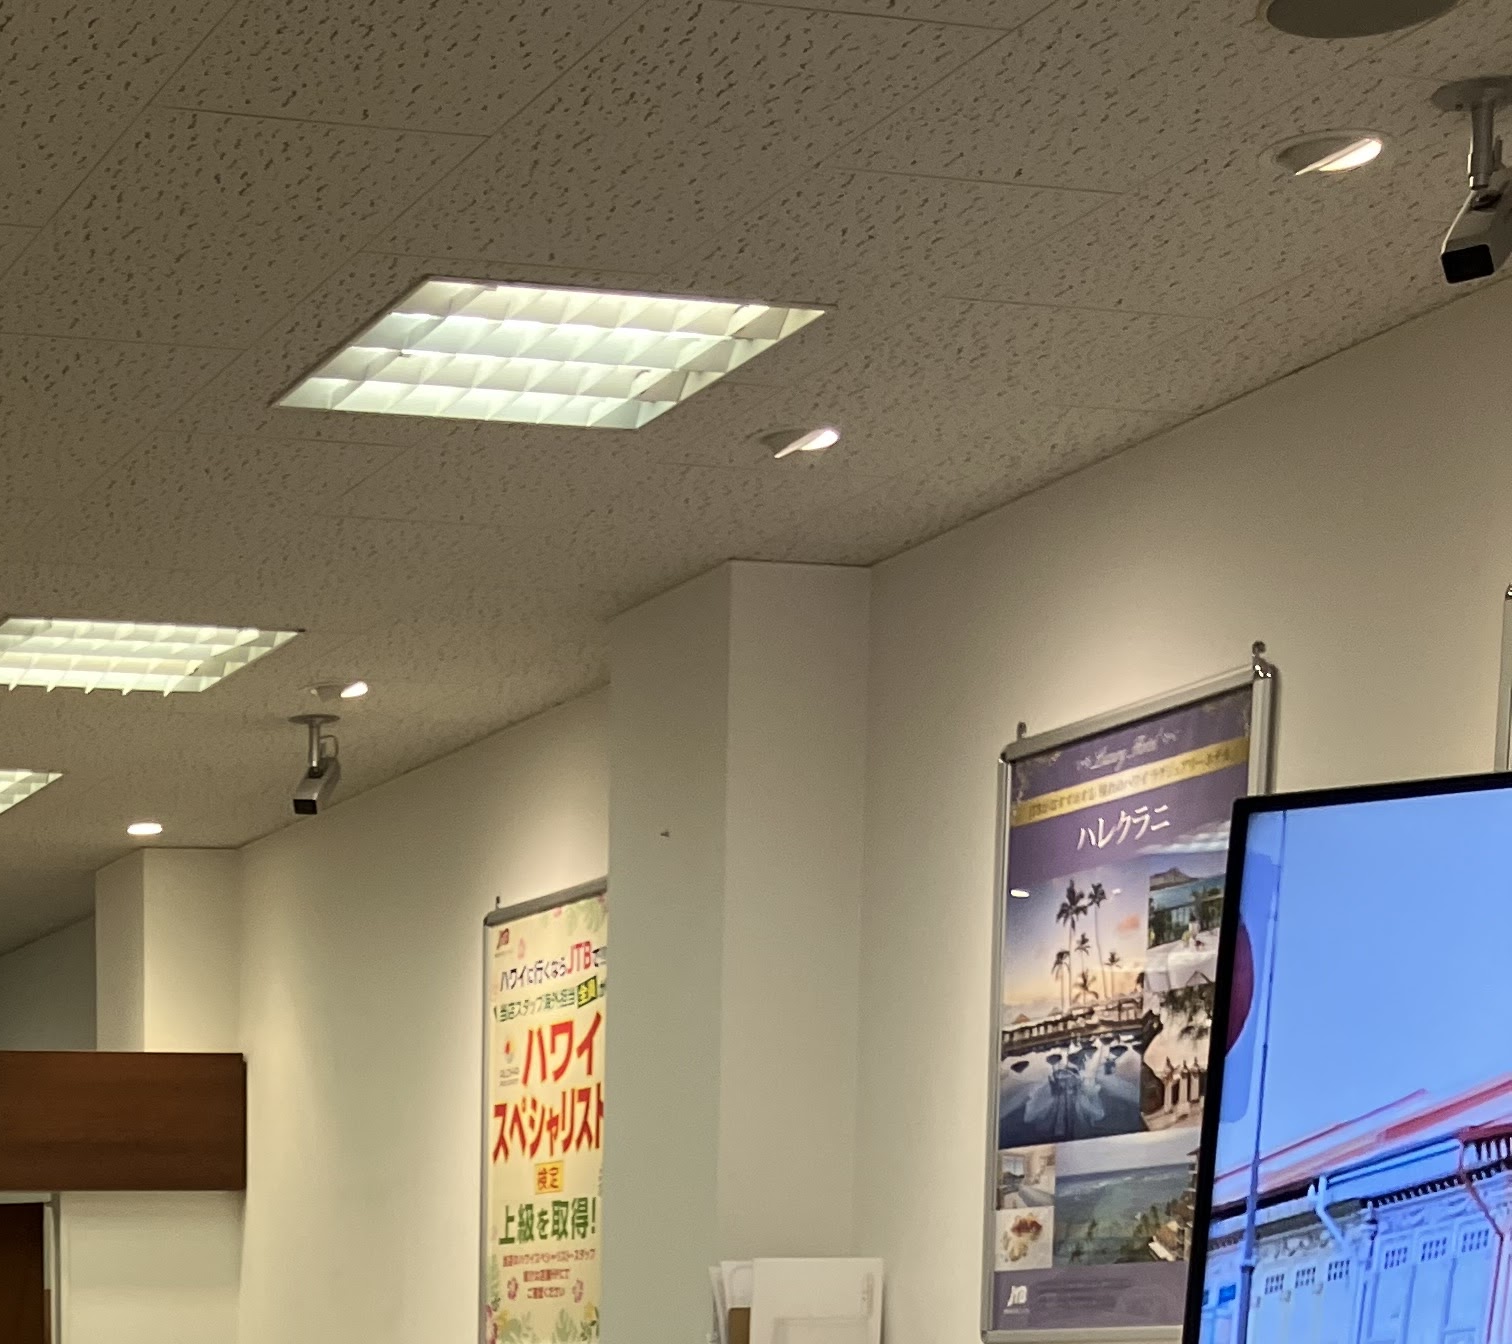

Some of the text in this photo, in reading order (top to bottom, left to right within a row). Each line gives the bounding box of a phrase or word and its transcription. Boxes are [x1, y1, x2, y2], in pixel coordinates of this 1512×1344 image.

[1076, 805, 1170, 851] ハレクラニ
[522, 1011, 602, 1087] ハワイ
[493, 1082, 604, 1164] スペシャリスト
